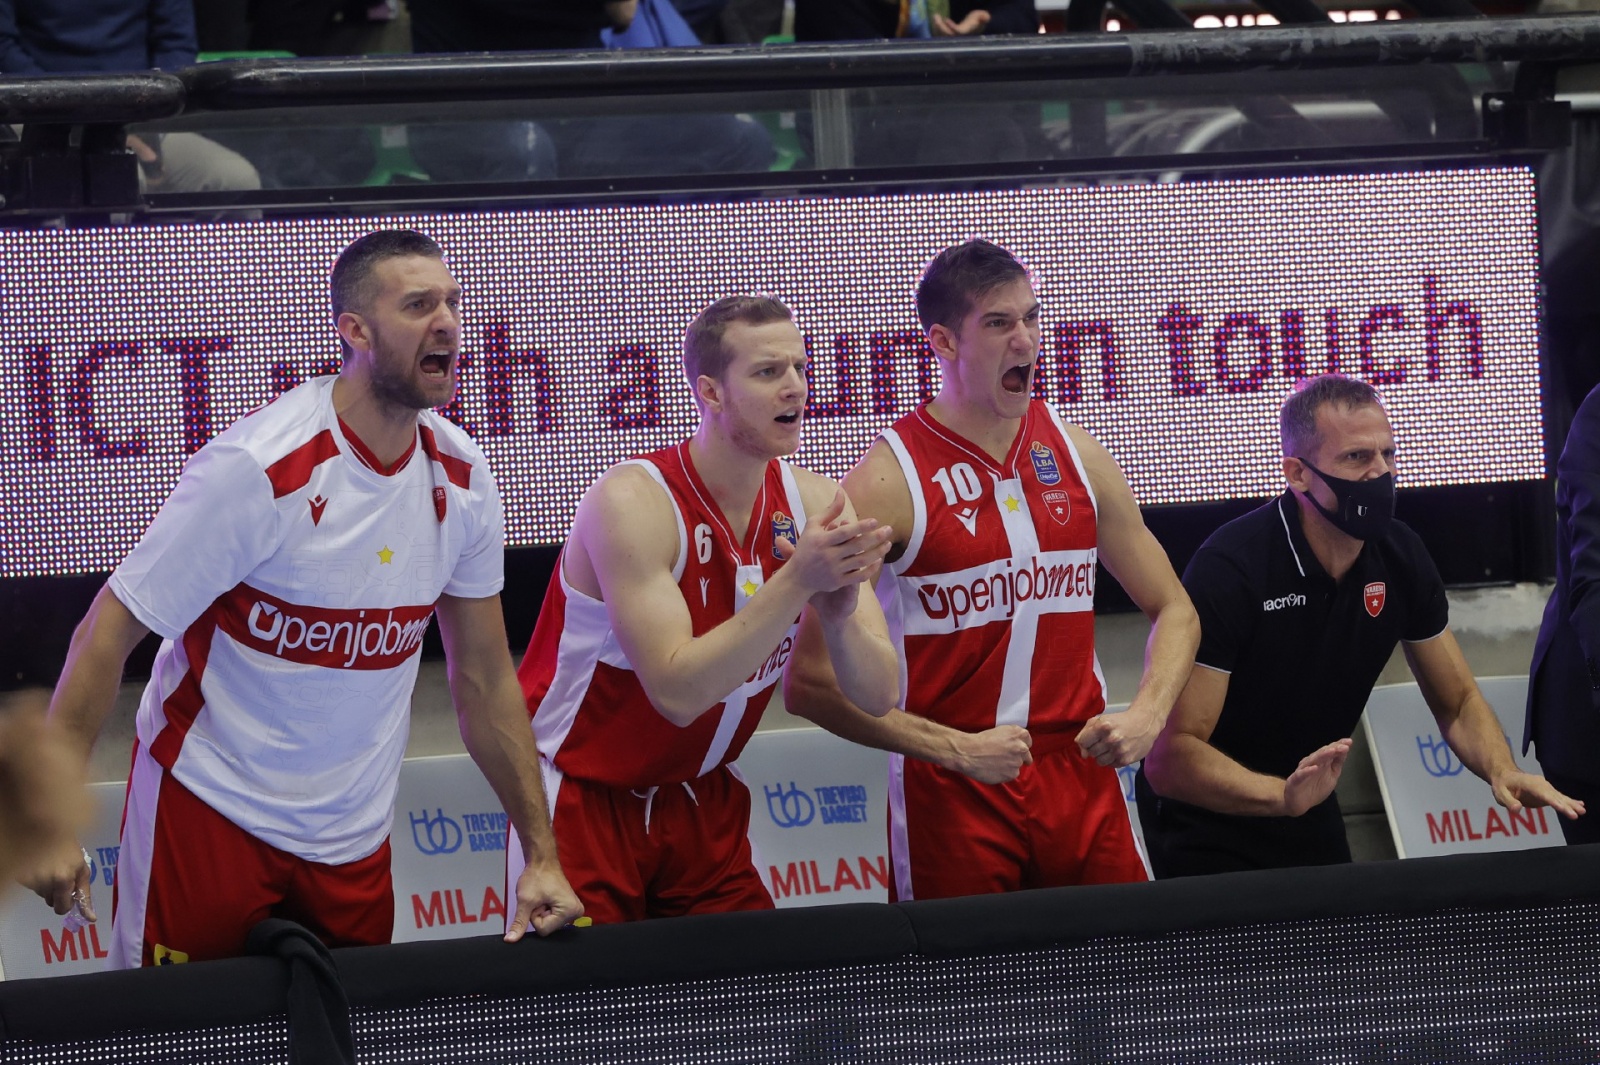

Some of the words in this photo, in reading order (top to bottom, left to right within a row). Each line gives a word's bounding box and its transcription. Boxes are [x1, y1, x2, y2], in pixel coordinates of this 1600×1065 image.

[25, 336, 232, 460] ICT
[603, 343, 662, 429] a
[1158, 272, 1484, 396] touch
[1036, 459, 1054, 467] LBA
[931, 462, 983, 506] 10
[694, 523, 712, 564] 6
[814, 785, 867, 805] TREVISO
[820, 804, 867, 824] BASKET
[468, 832, 507, 852] BASK
[1425, 807, 1549, 844] MILANI
[769, 856, 889, 899] MILAN
[411, 886, 505, 929] MILA
[40, 924, 109, 964] MIL
